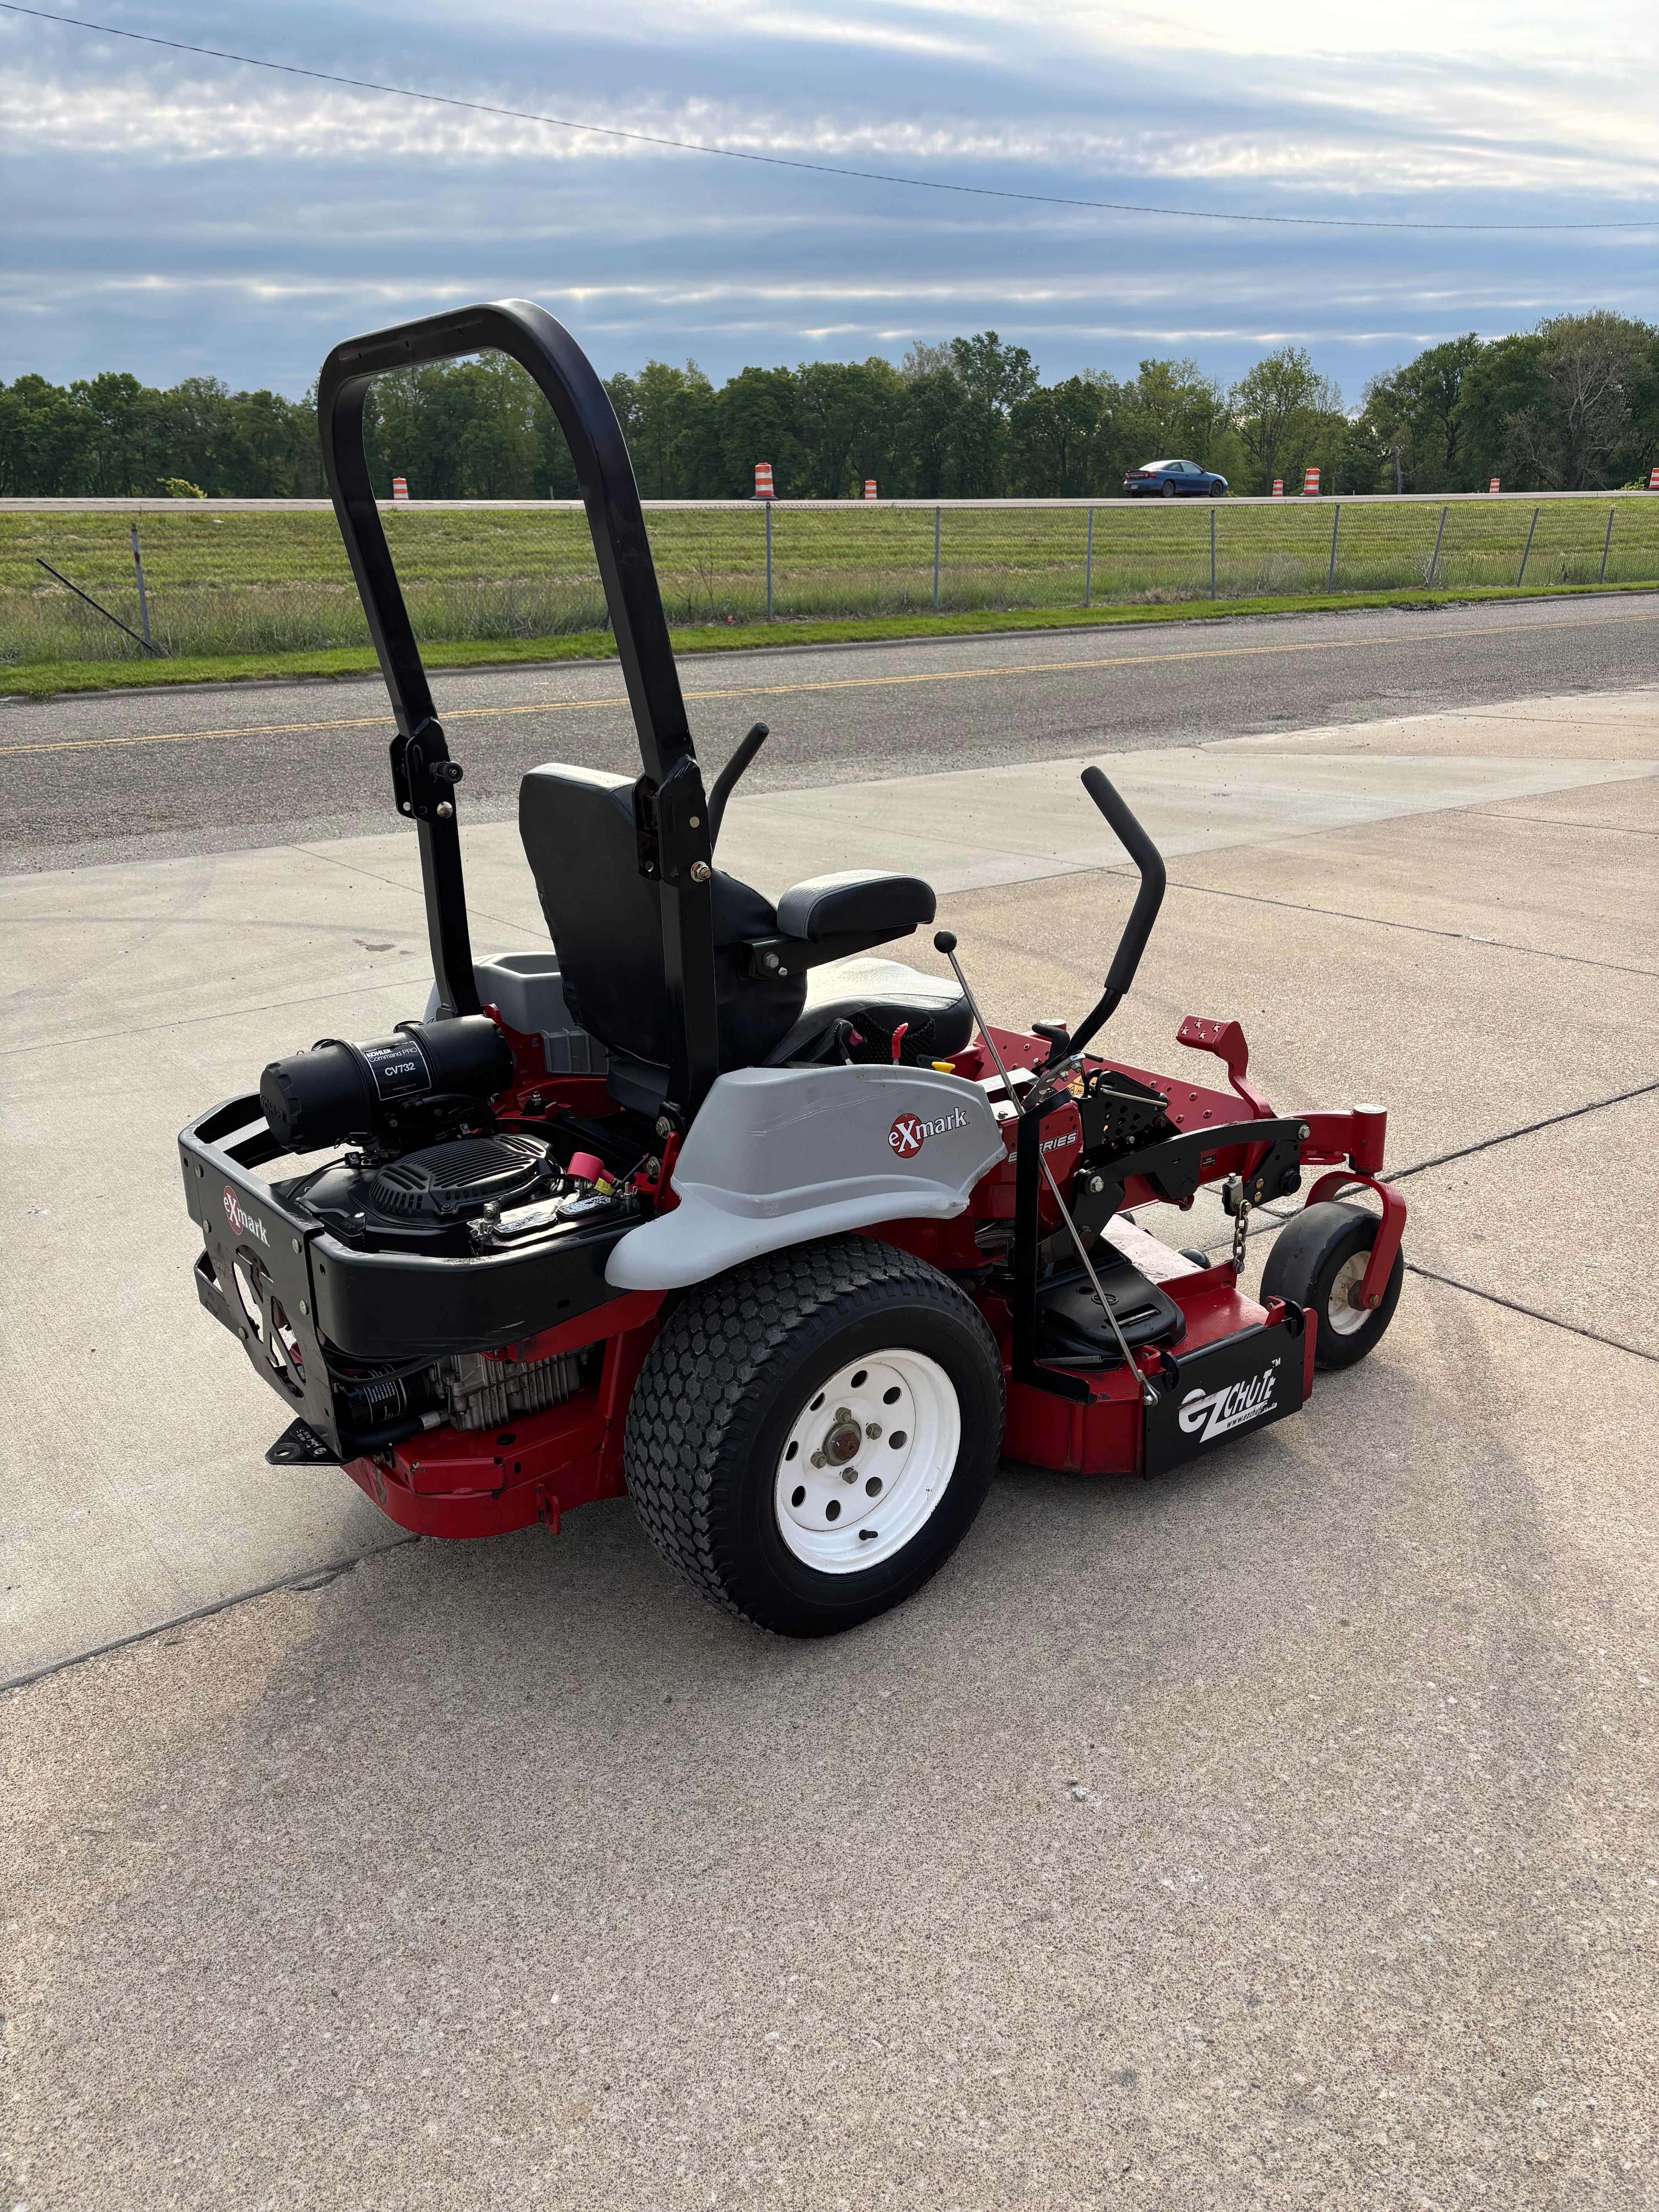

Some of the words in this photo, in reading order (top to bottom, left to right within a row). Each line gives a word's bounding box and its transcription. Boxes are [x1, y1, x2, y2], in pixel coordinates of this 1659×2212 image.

[366, 1049, 393, 1058] KOHLER
[369, 1051, 402, 1062] Command
[385, 1062, 416, 1076] CV732
